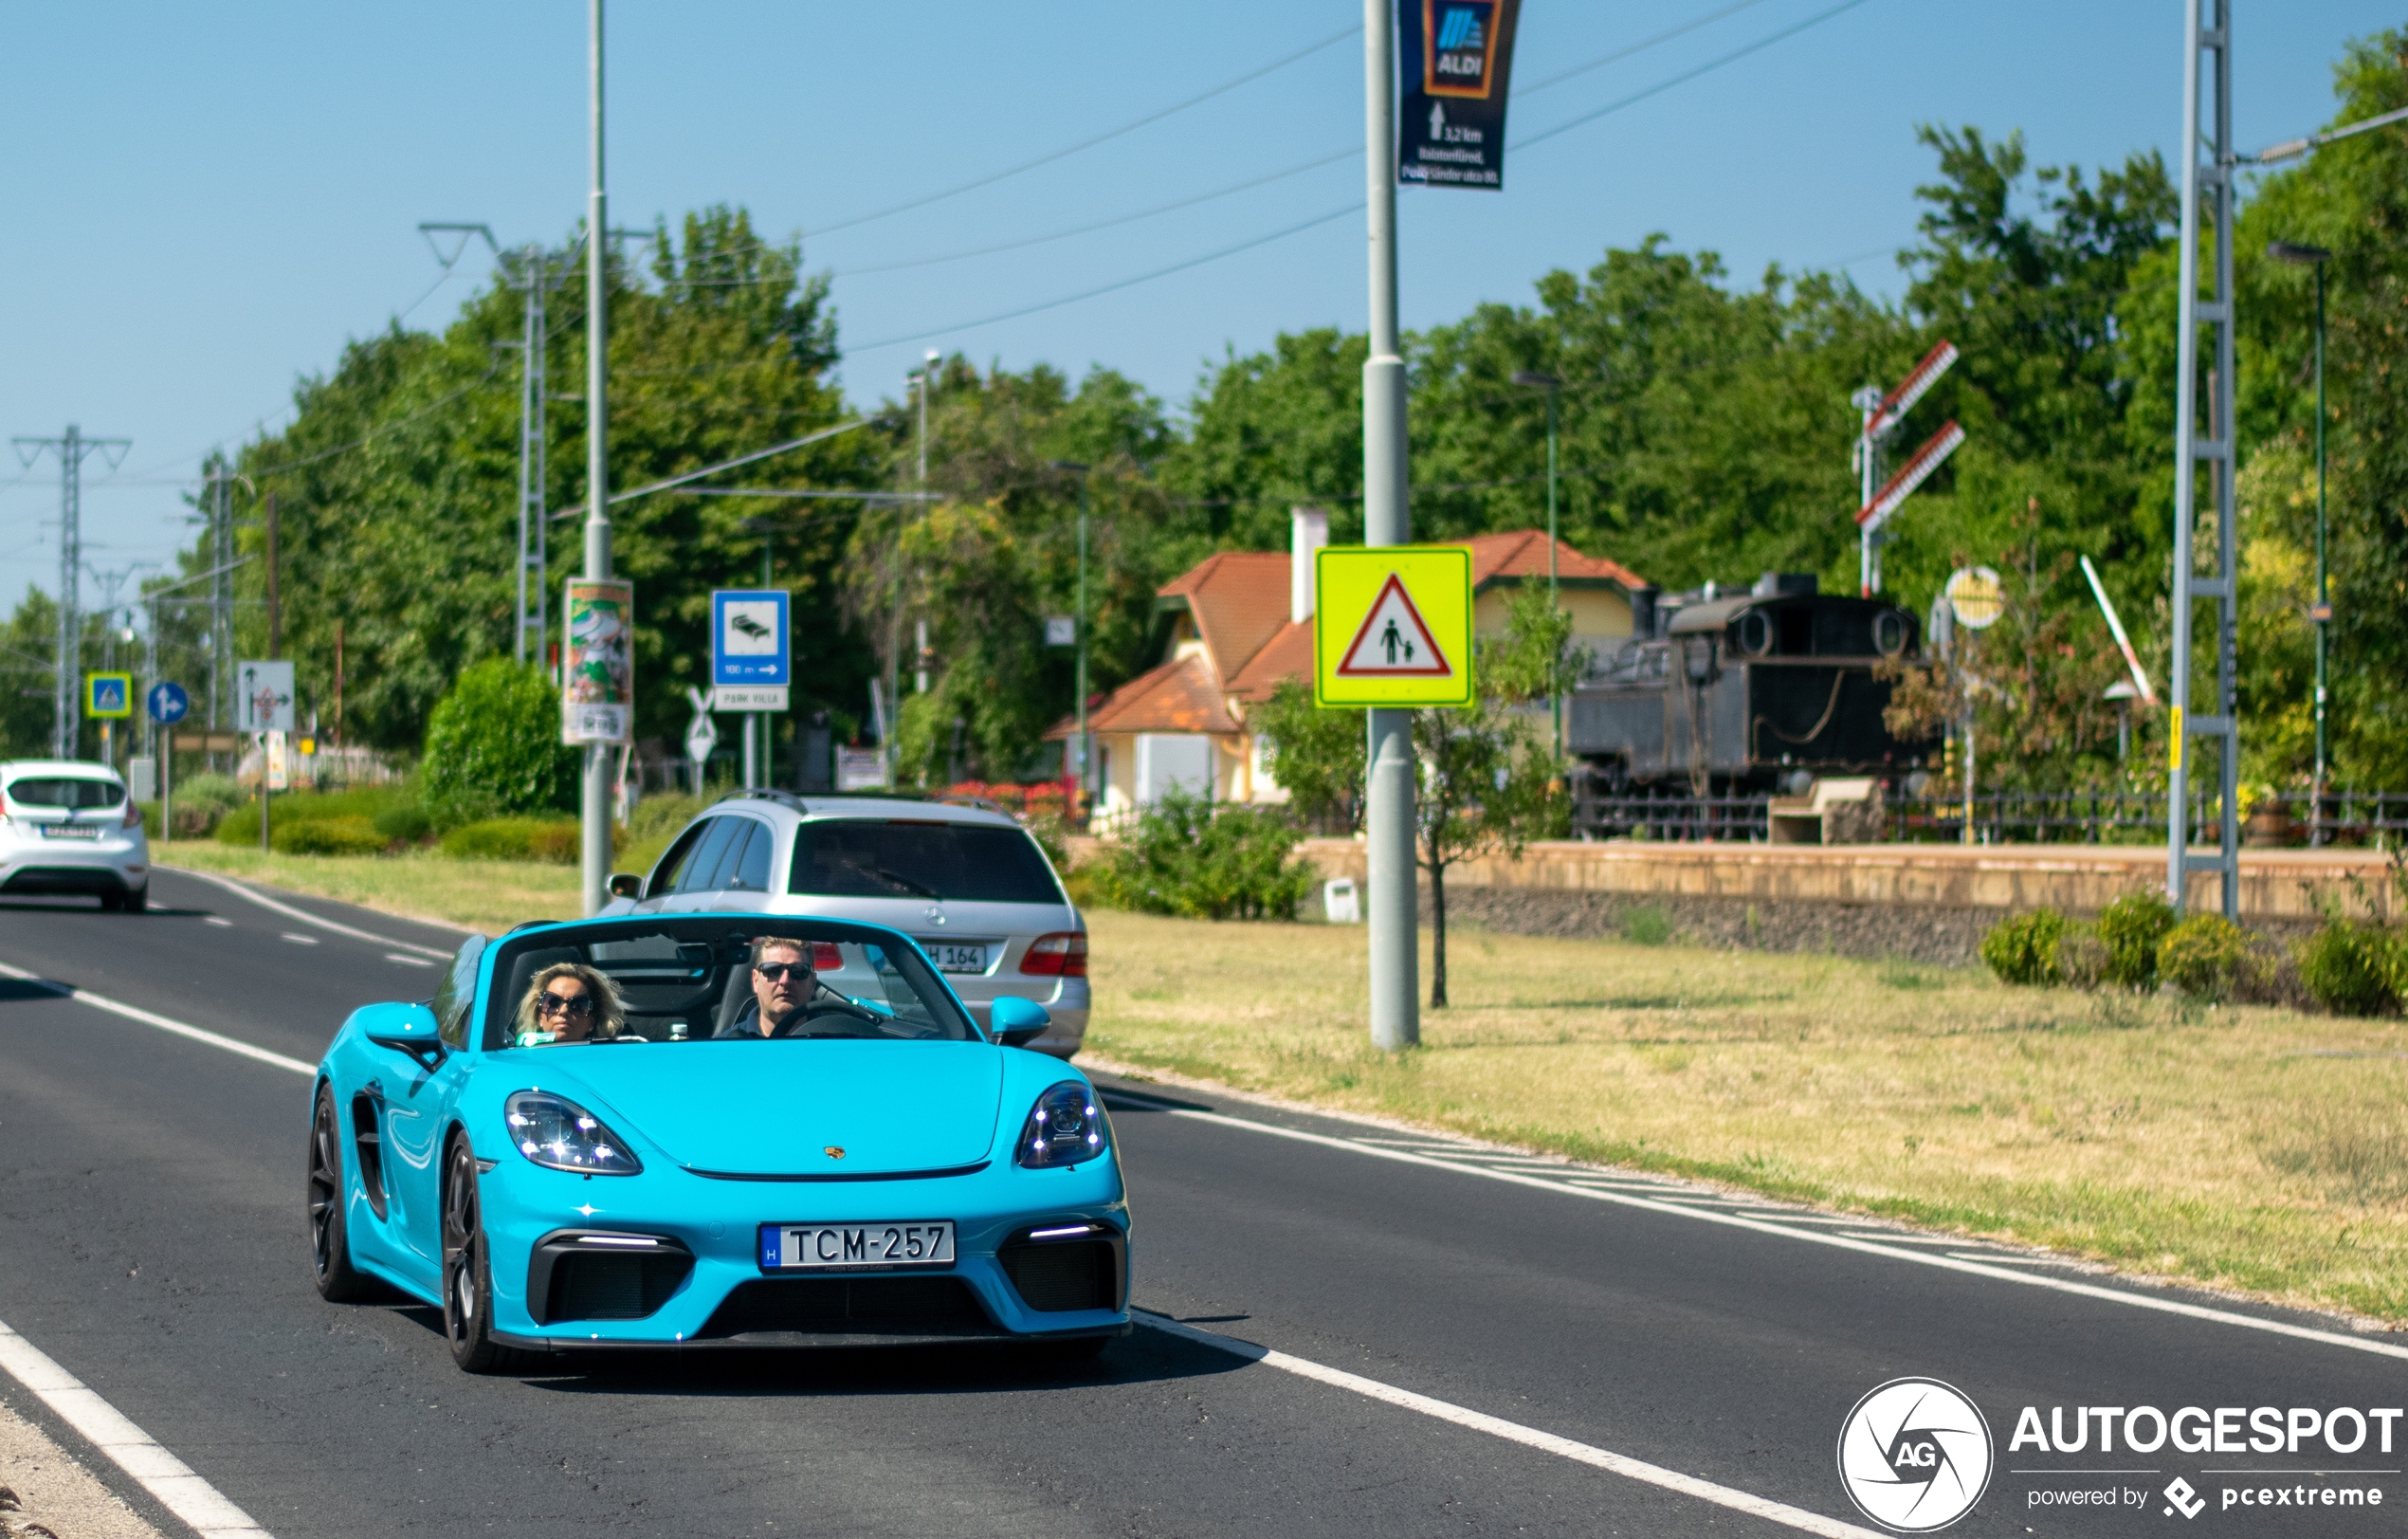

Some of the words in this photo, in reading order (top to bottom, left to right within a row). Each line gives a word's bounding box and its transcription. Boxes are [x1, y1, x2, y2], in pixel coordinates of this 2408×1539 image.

[1437, 54, 1483, 76] ALDI
[1445, 126, 1461, 142] 3,2
[1463, 128, 1483, 143] km
[724, 693, 749, 704] PARK
[752, 693, 778, 704] VILLA
[946, 947, 978, 965] 164
[766, 1249, 776, 1260] H
[789, 1226, 945, 1262] TCM-257
